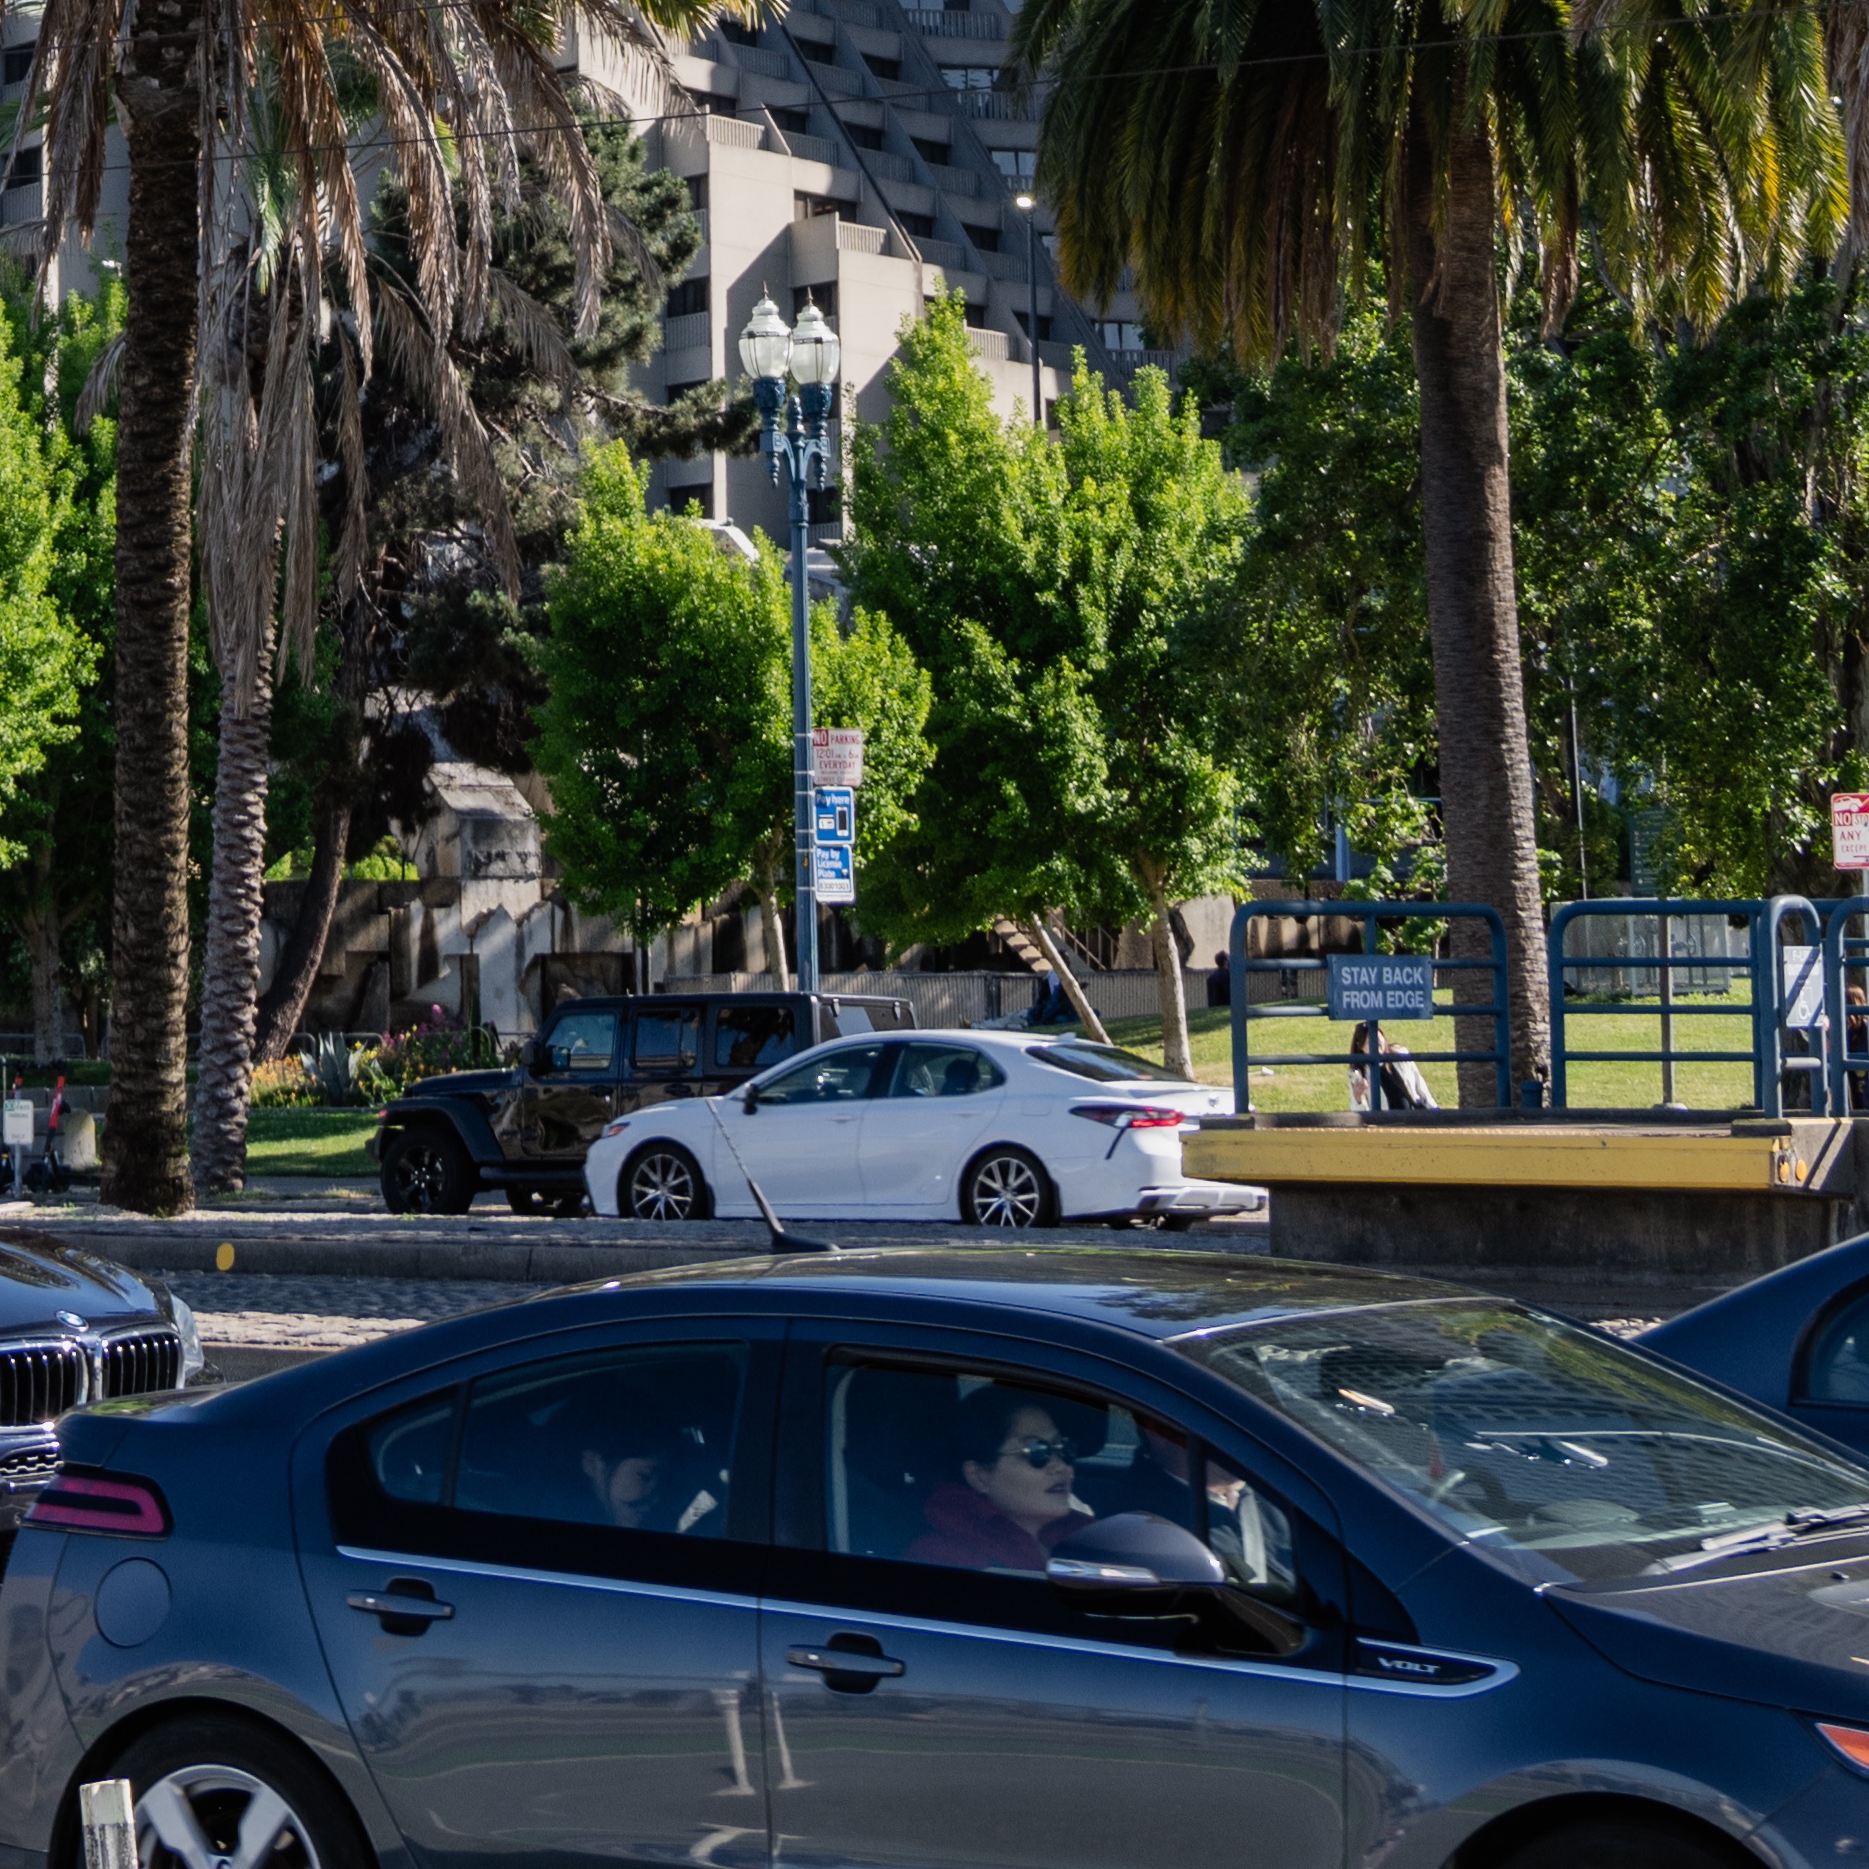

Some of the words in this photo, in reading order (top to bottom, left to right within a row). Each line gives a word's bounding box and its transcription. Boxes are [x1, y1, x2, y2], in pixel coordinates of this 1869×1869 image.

[814, 730, 828, 745] NO
[830, 734, 861, 745] PARKING
[819, 759, 856, 769] EVERYDAY
[816, 794, 831, 807] Pay
[831, 793, 850, 805] here
[1835, 813, 1851, 826] NO
[1840, 830, 1860, 841] ANY
[817, 848, 830, 860] Pay
[830, 848, 840, 860] by
[1341, 966, 1378, 985] STAY
[1382, 966, 1424, 985] BACK
[1342, 990, 1383, 1009] FROM
[1386, 990, 1425, 1009] EDGE
[1377, 1656, 1441, 1674] VOLT
